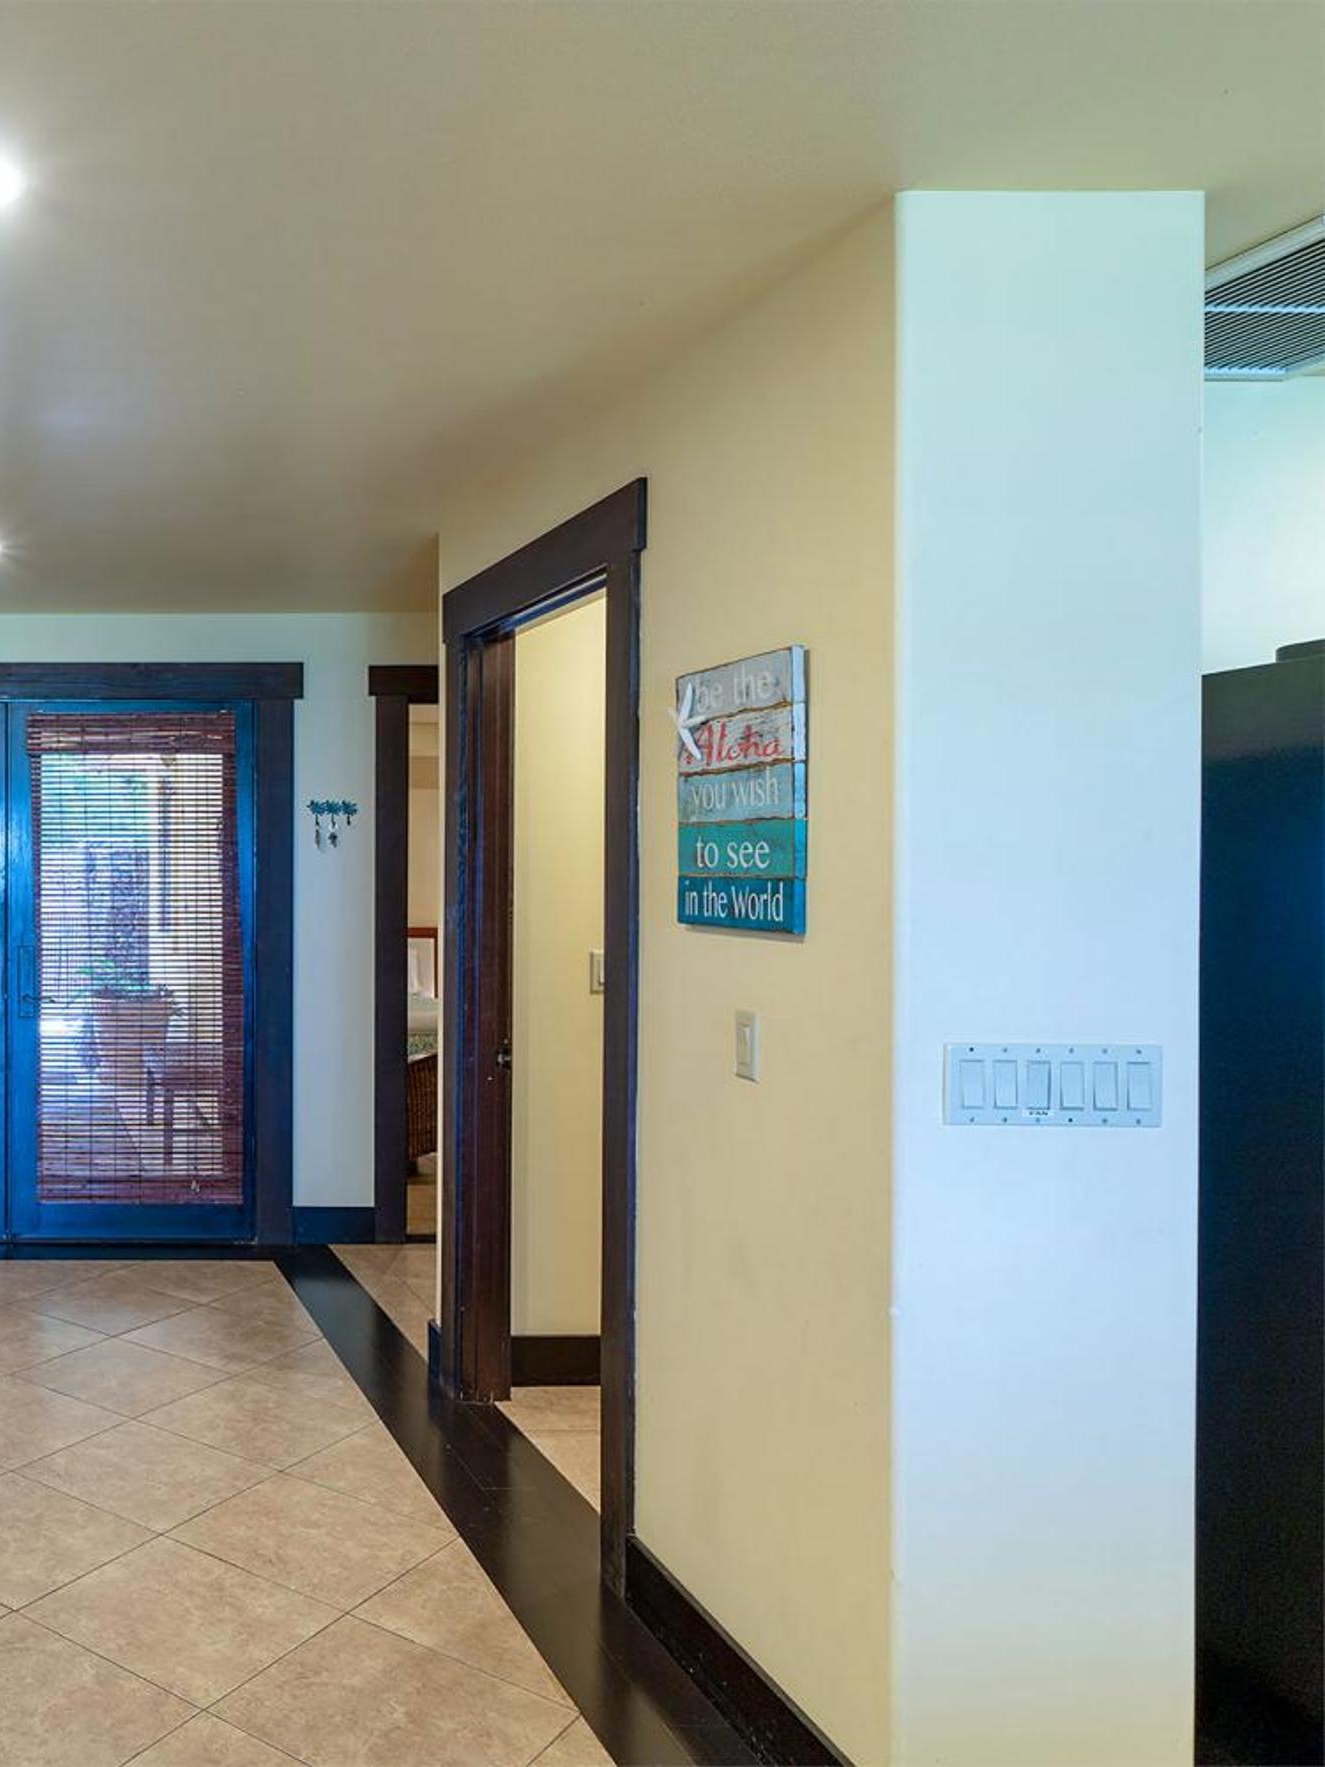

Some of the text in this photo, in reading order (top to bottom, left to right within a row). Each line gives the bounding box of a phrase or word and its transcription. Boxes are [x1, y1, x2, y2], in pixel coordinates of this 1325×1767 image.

[694, 664, 772, 710] be the
[684, 717, 786, 766] Aloha
[690, 766, 779, 818] you wish
[695, 835, 771, 869] to see
[684, 879, 784, 922] in the World
